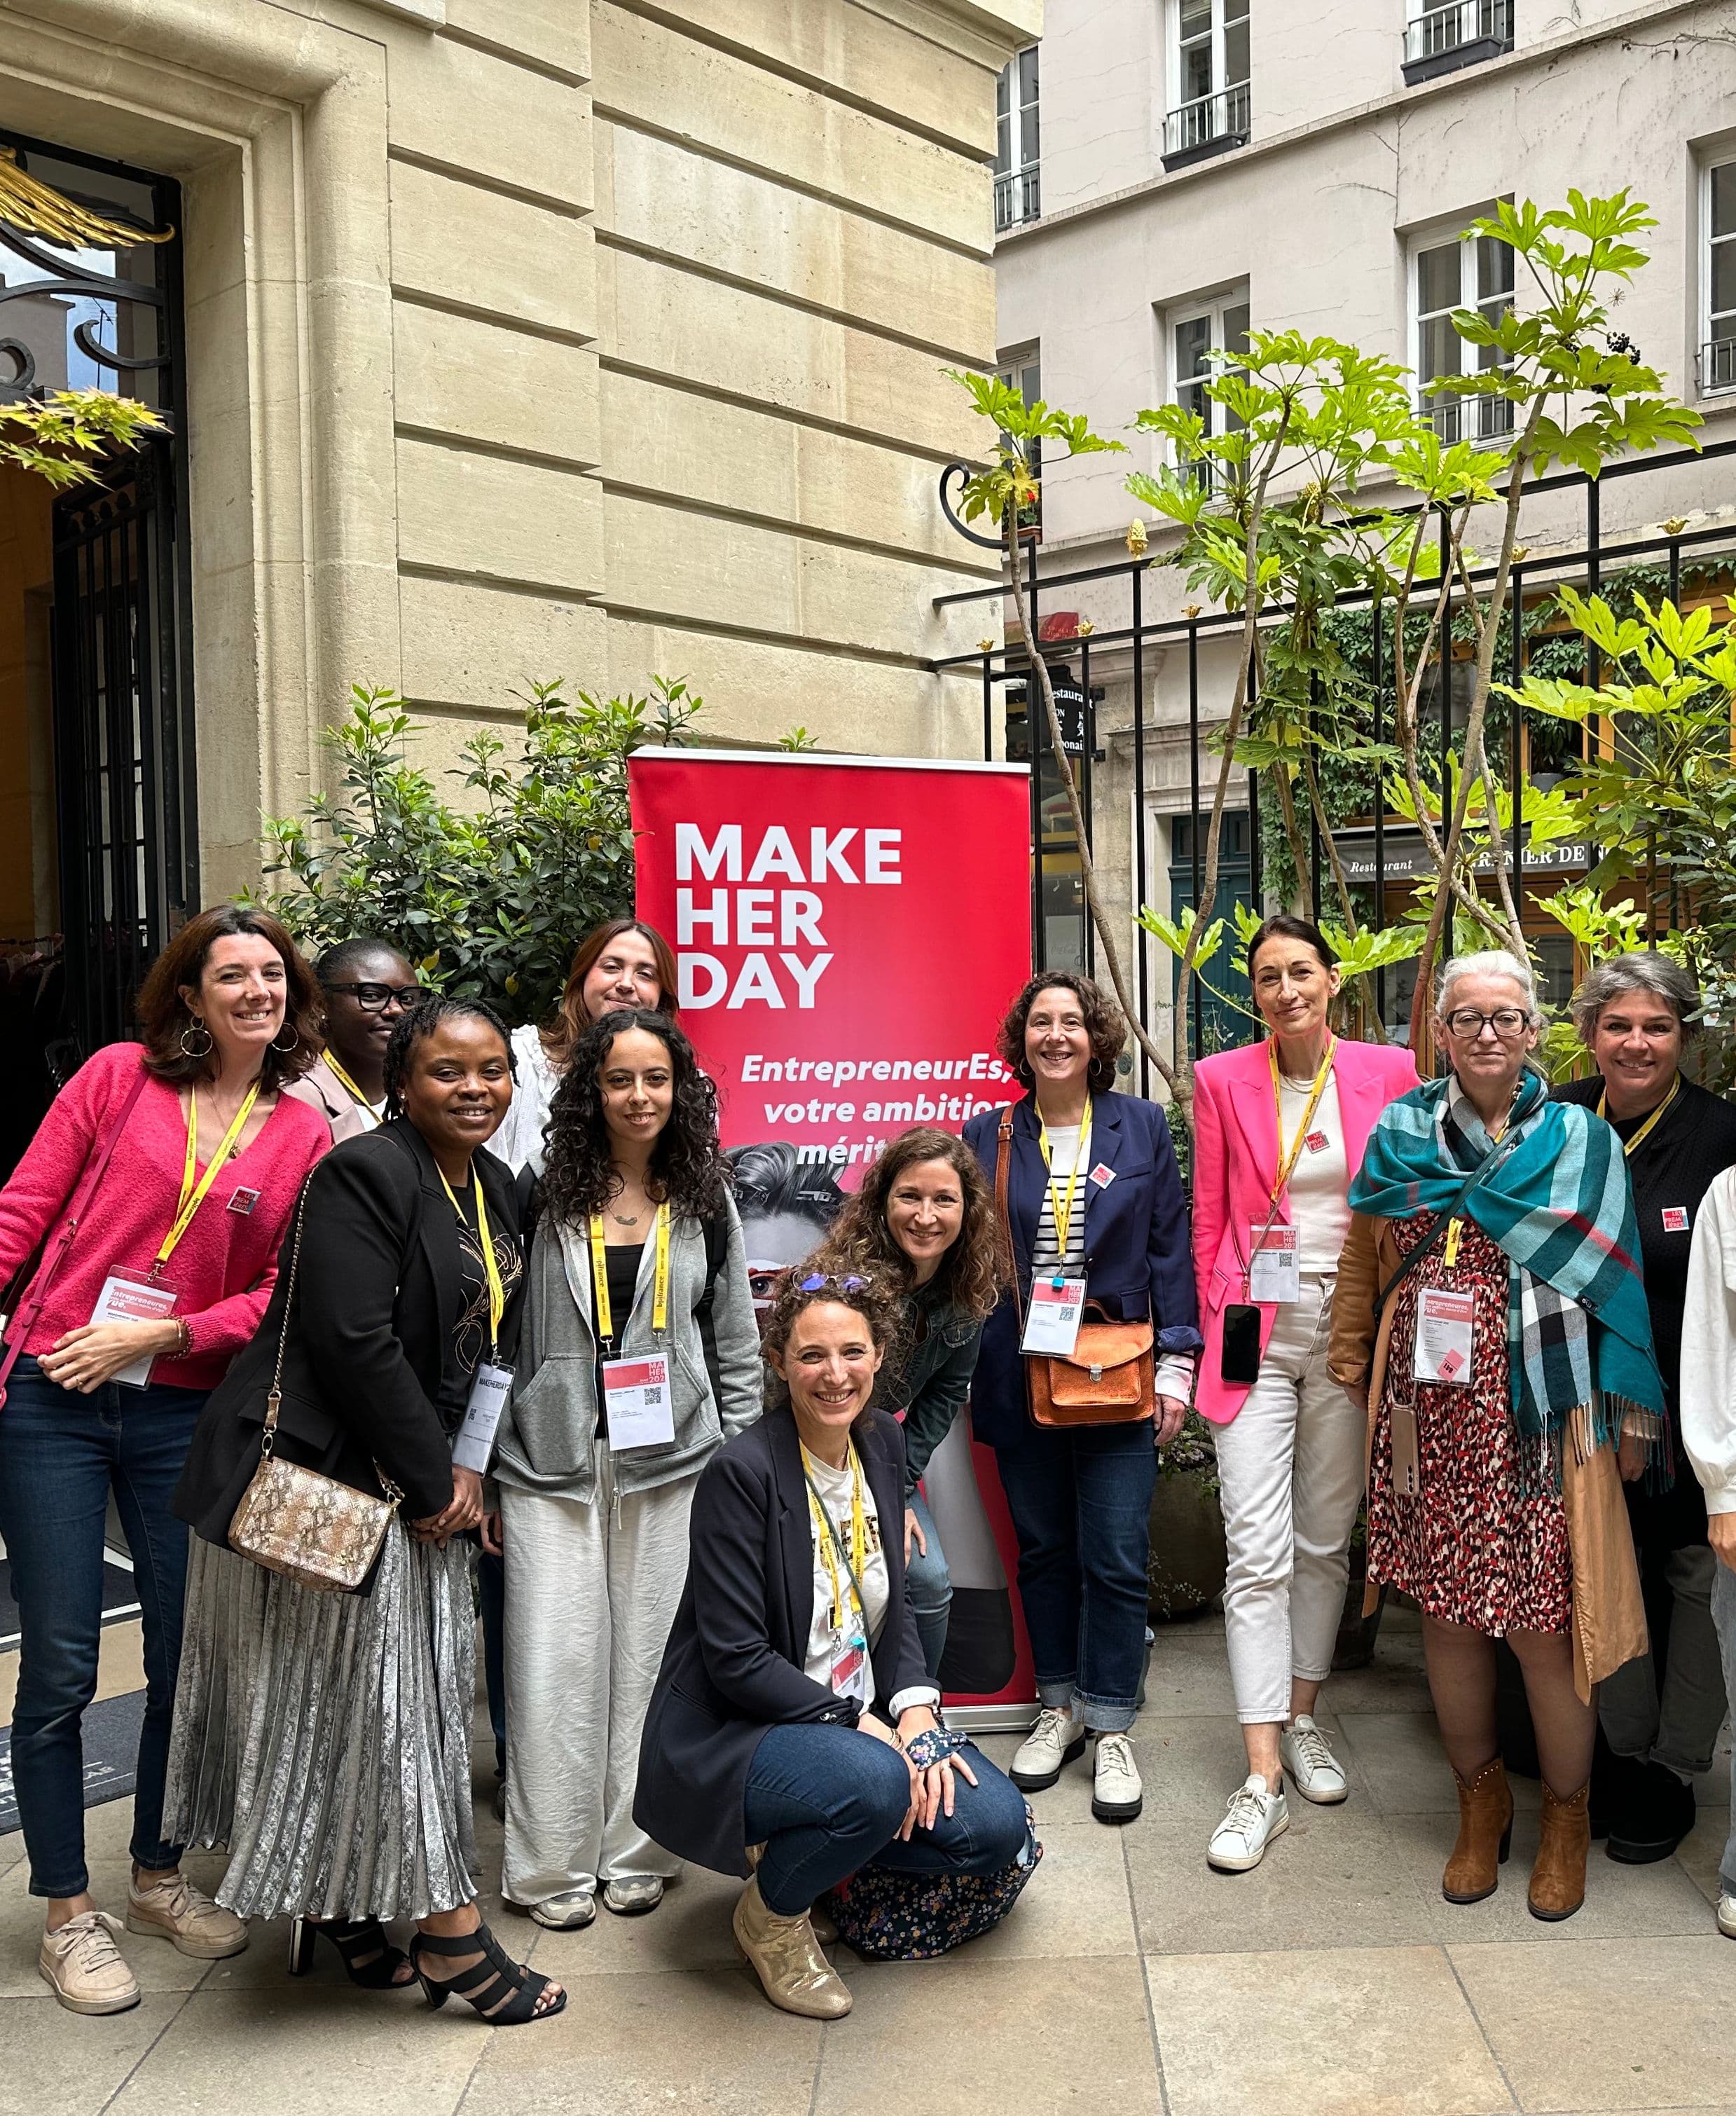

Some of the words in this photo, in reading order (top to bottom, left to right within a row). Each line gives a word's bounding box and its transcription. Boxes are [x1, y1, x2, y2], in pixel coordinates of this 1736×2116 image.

[1052, 689, 1093, 709] estaurat
[675, 823, 902, 885] MAKE
[1559, 845, 1585, 863] DE
[676, 888, 828, 947] HER
[678, 952, 834, 1010] DAY
[741, 1053, 1012, 1087] EntrepreneurEs,
[764, 1098, 855, 1123] votre
